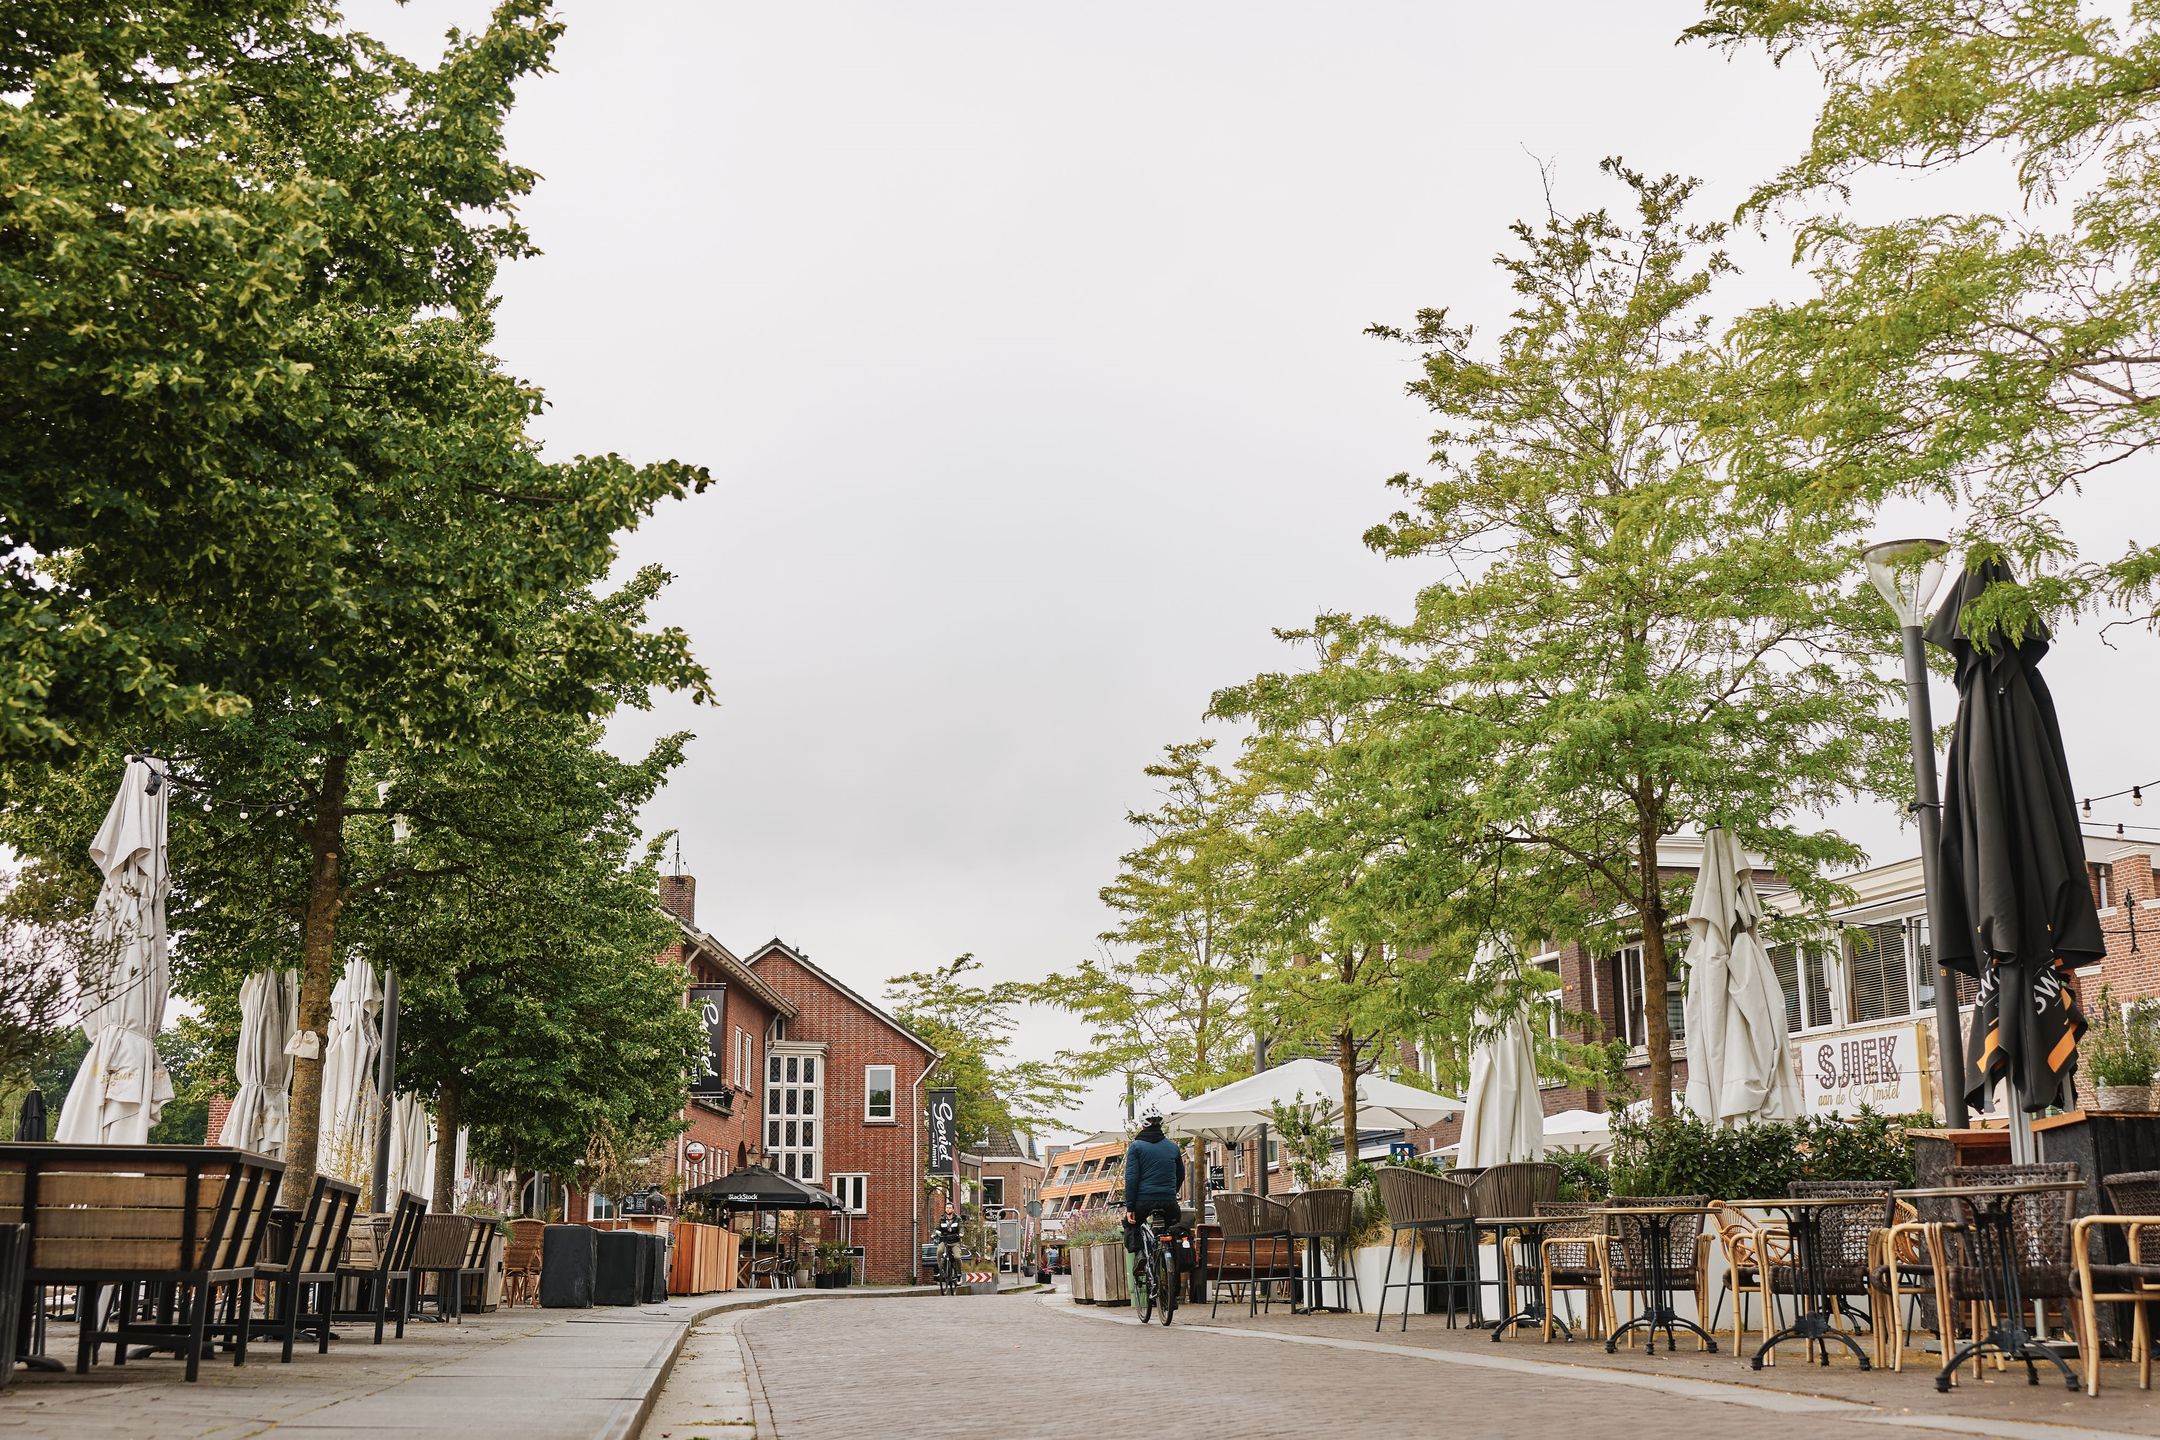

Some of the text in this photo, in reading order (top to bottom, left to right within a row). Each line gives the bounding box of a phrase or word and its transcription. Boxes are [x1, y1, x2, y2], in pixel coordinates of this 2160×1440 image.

[699, 995, 719, 1077] Giet
[1818, 1035, 1898, 1089] SJIEK
[1818, 1094, 1833, 1106] aan
[1848, 1063, 1902, 1112] Amstel
[933, 1097, 953, 1161] Geniet
